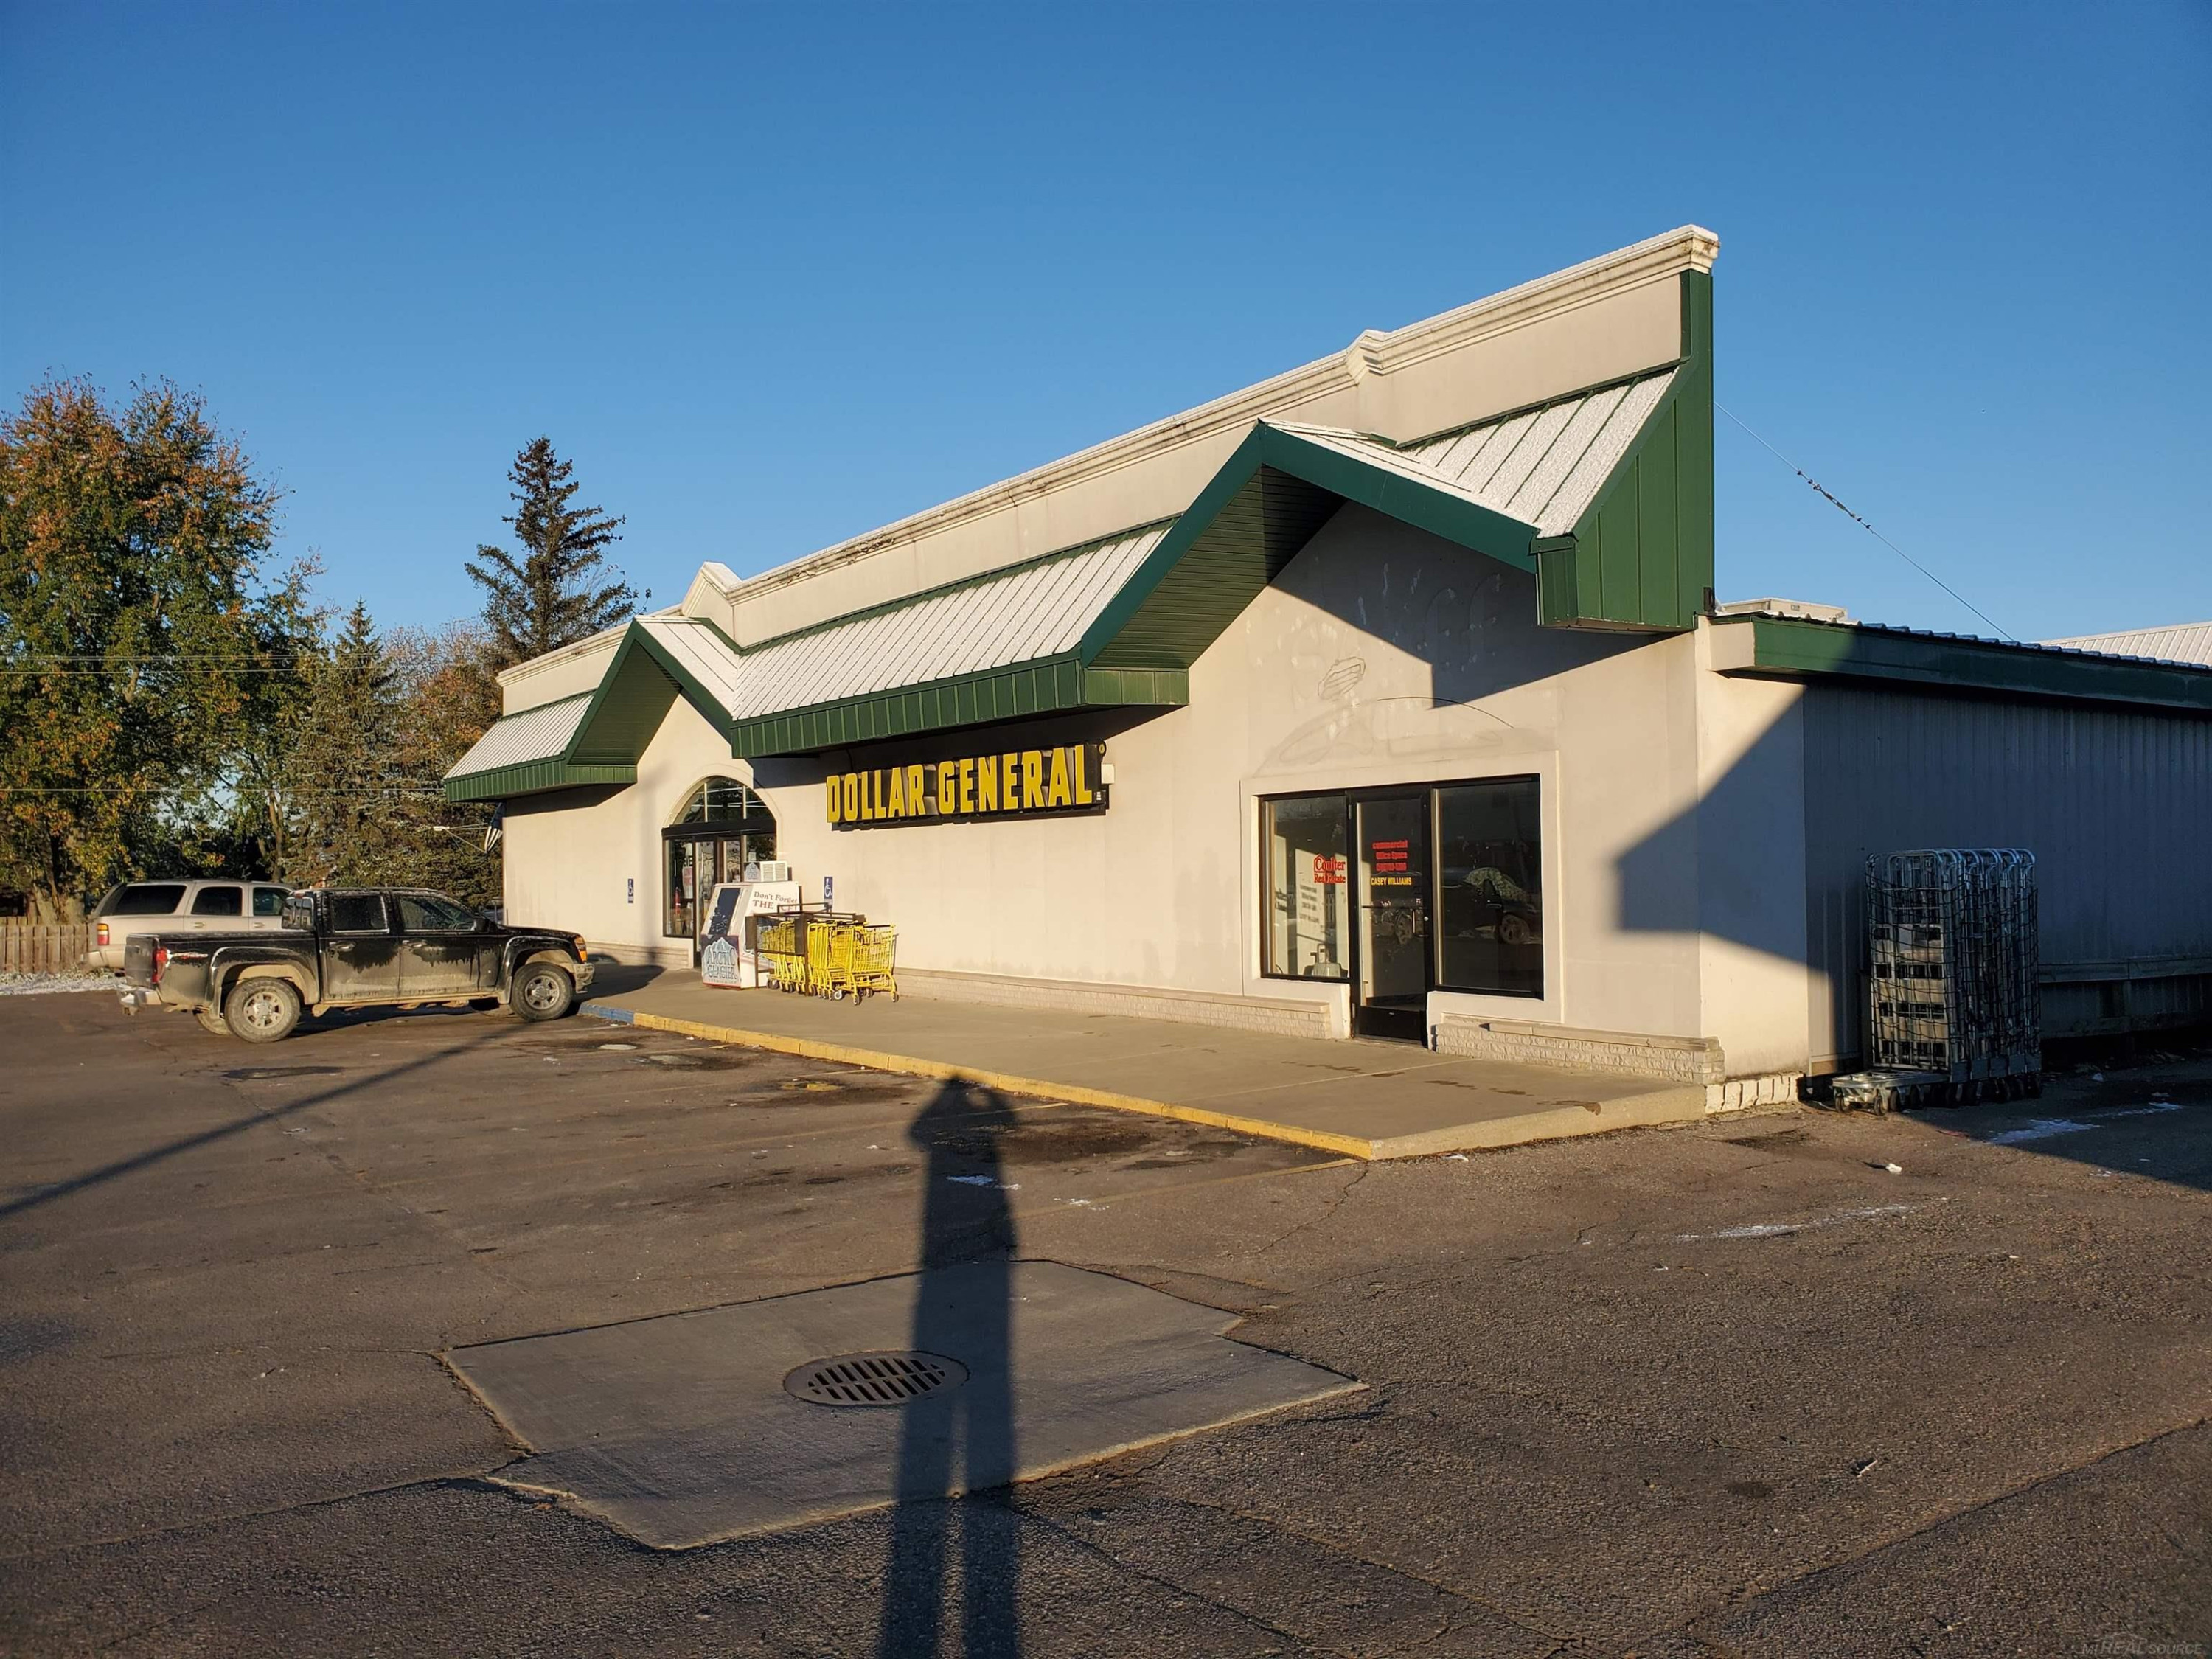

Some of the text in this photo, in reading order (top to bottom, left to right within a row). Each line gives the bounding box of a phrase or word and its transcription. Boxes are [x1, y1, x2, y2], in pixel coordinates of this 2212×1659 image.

[826, 745, 1093, 823] DOLLAR GENERAL
[1315, 856, 1346, 871] Coulter
[1314, 873, 1328, 883] Real
[1371, 877, 1412, 886] CASEY WILLIAMS
[752, 899, 774, 910] THE
[754, 891, 798, 904] Don't Forget
[706, 947, 736, 967] ARCTIC
[707, 964, 737, 980] GLACIER
